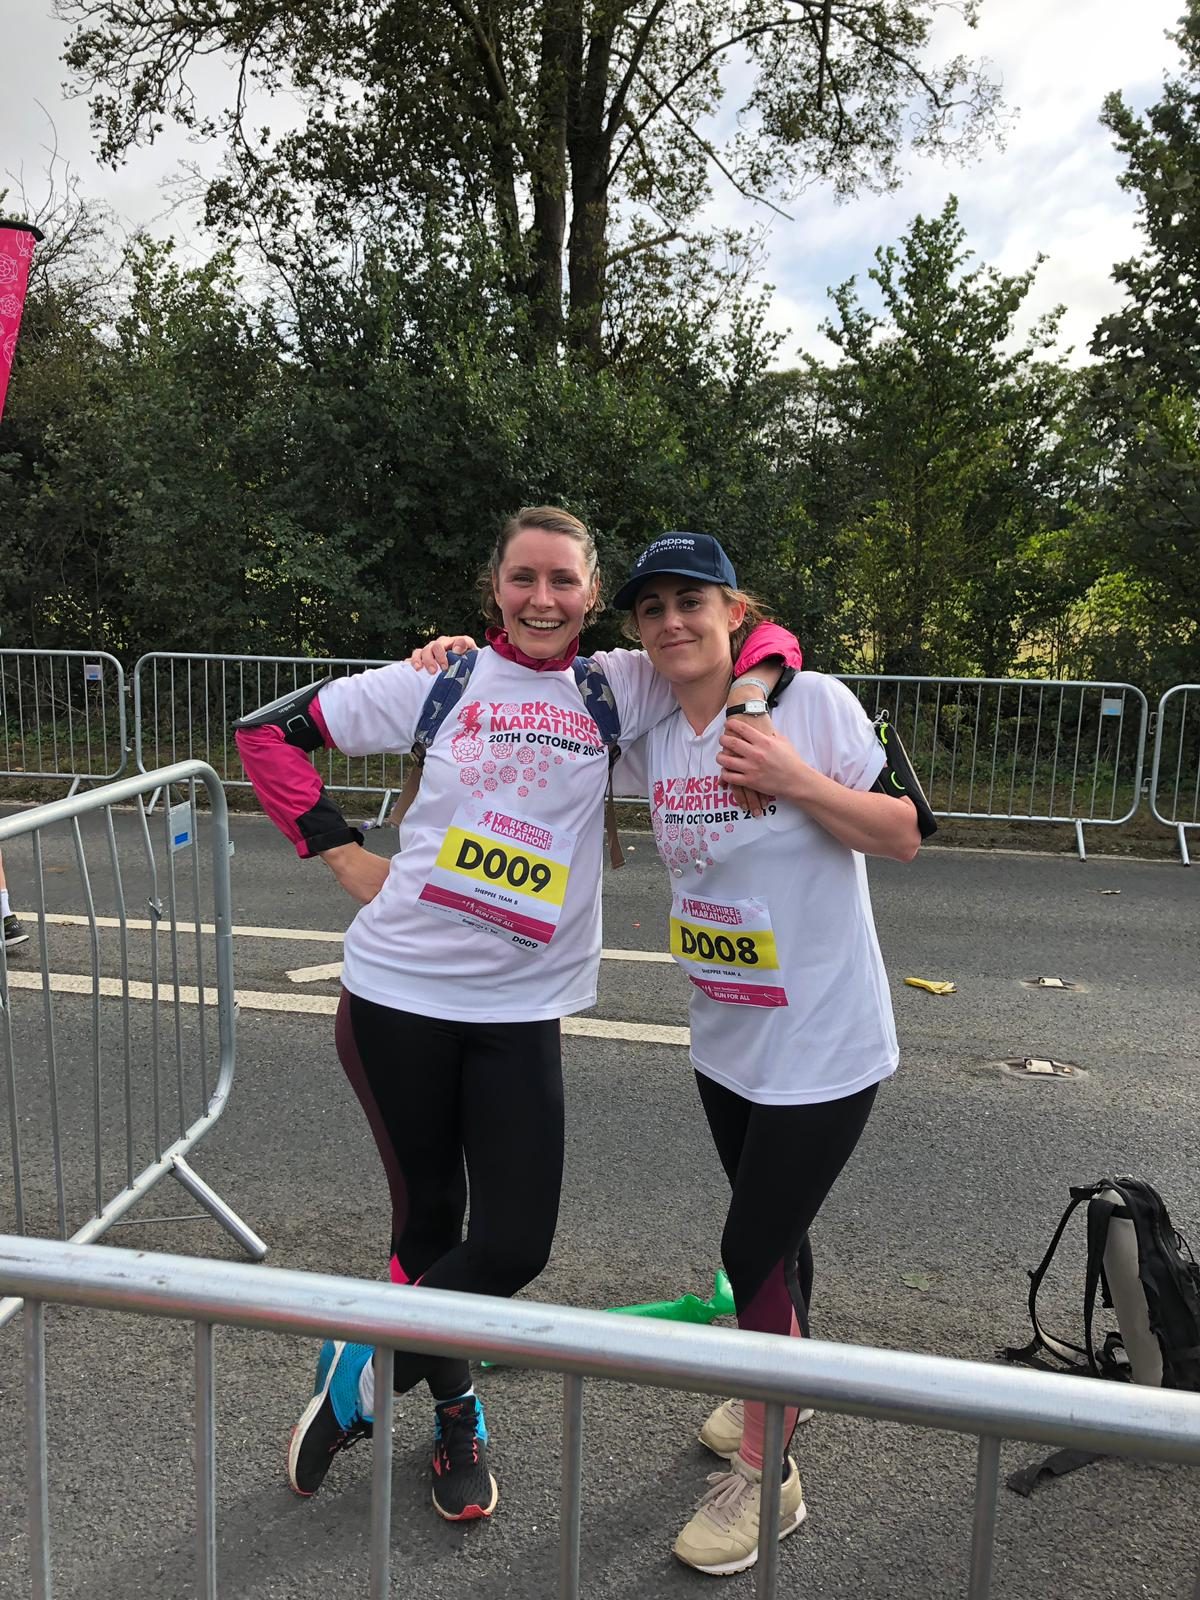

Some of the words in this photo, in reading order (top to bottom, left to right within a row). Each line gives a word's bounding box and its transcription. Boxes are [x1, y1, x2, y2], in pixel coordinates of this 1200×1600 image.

[489, 701, 598, 735] YORKSHIRE
[490, 715, 602, 748] MARATHON
[488, 732, 521, 743] 20TH
[526, 732, 580, 754] OCTOBER
[665, 775, 729, 794] YORKSH
[664, 813, 684, 825] 20TH
[686, 810, 739, 825] OCTOBER
[743, 804, 777, 820] 219
[492, 823, 547, 848] MARATHON
[496, 813, 549, 840] YORKSHIRE
[455, 838, 551, 893] D009
[475, 887, 497, 899] SHEPPEE
[498, 894, 513, 904] TEAM
[475, 908, 490, 918] RUN
[489, 914, 503, 923] FOR
[502, 920, 514, 928] ALL
[689, 900, 735, 916] YORKSHIRE
[692, 909, 737, 924] MARATHON
[511, 935, 538, 949] D009
[680, 925, 759, 965] D008
[713, 991, 727, 999] RUN
[727, 992, 739, 1000] FOR
